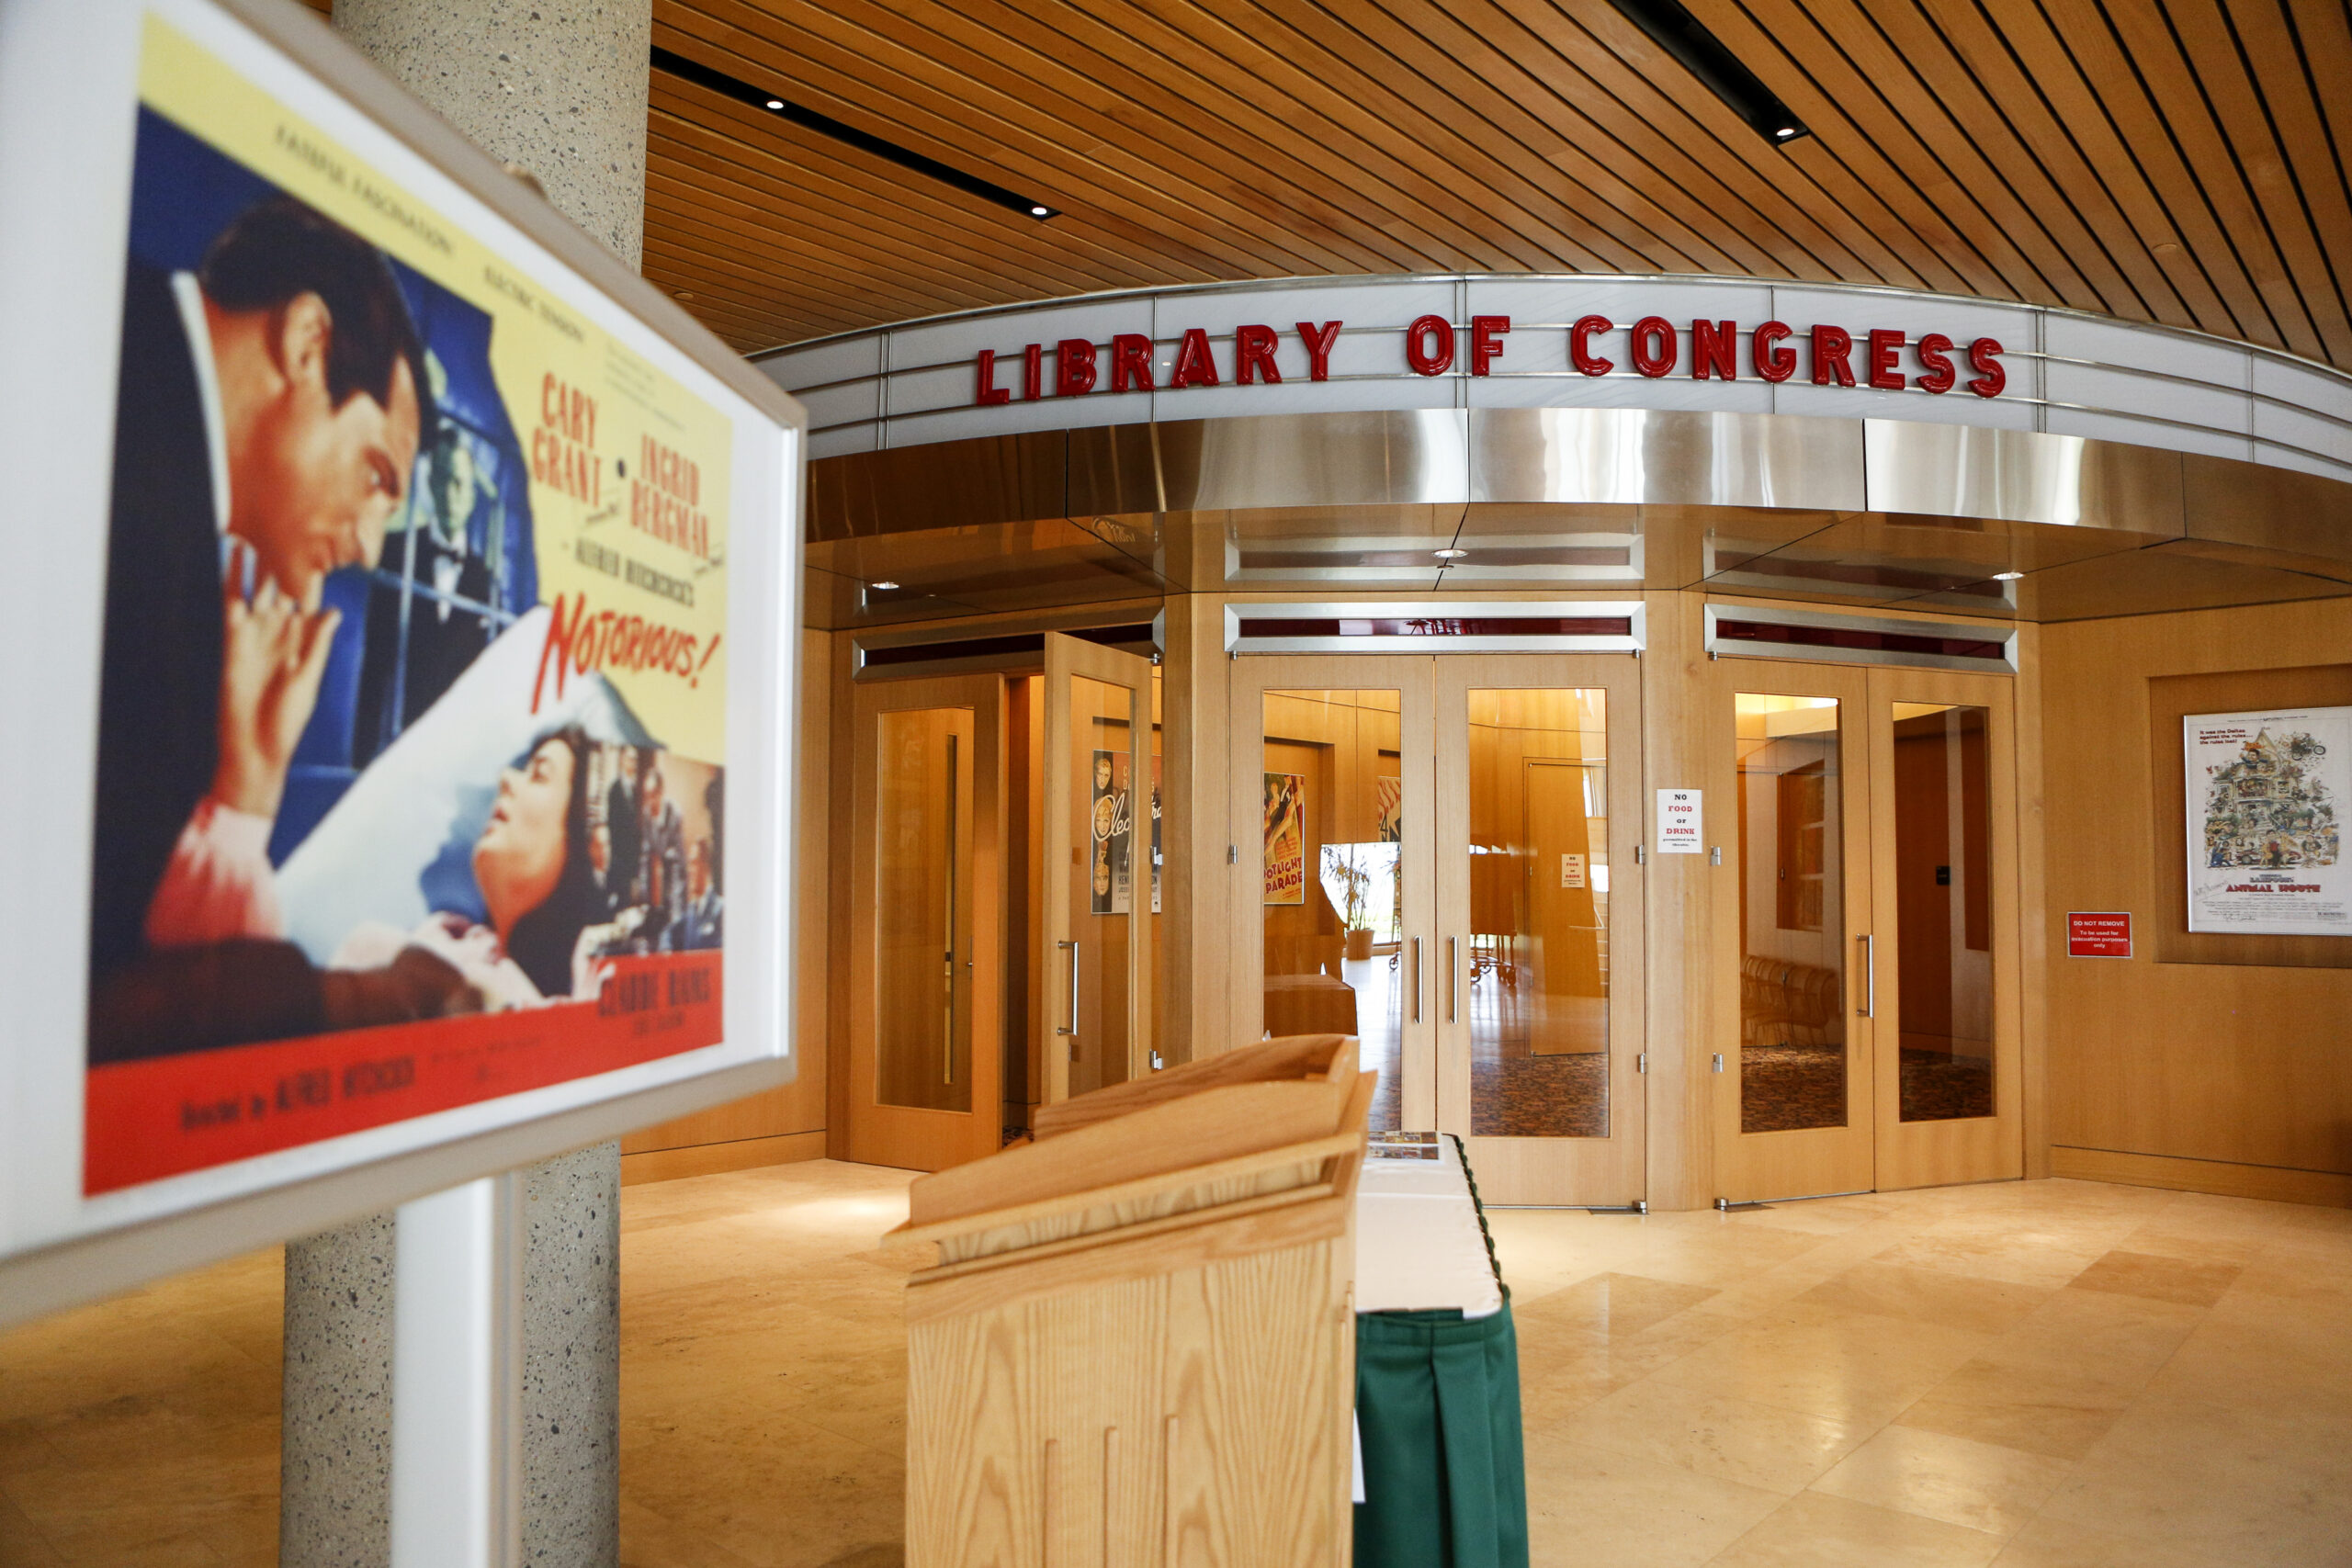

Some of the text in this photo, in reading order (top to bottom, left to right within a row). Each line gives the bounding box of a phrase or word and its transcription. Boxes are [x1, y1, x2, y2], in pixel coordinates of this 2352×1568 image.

[976, 314, 2007, 406] LIBRARY OF CONGRESS
[542, 371, 596, 449] CARY
[533, 426, 602, 508] GRANT
[640, 433, 700, 507] INGRID
[631, 478, 709, 560] BERGMAN
[1264, 856, 1302, 879] OTLIGHT
[1265, 870, 1303, 895] PARADE
[2225, 884, 2275, 893] ANIMAL
